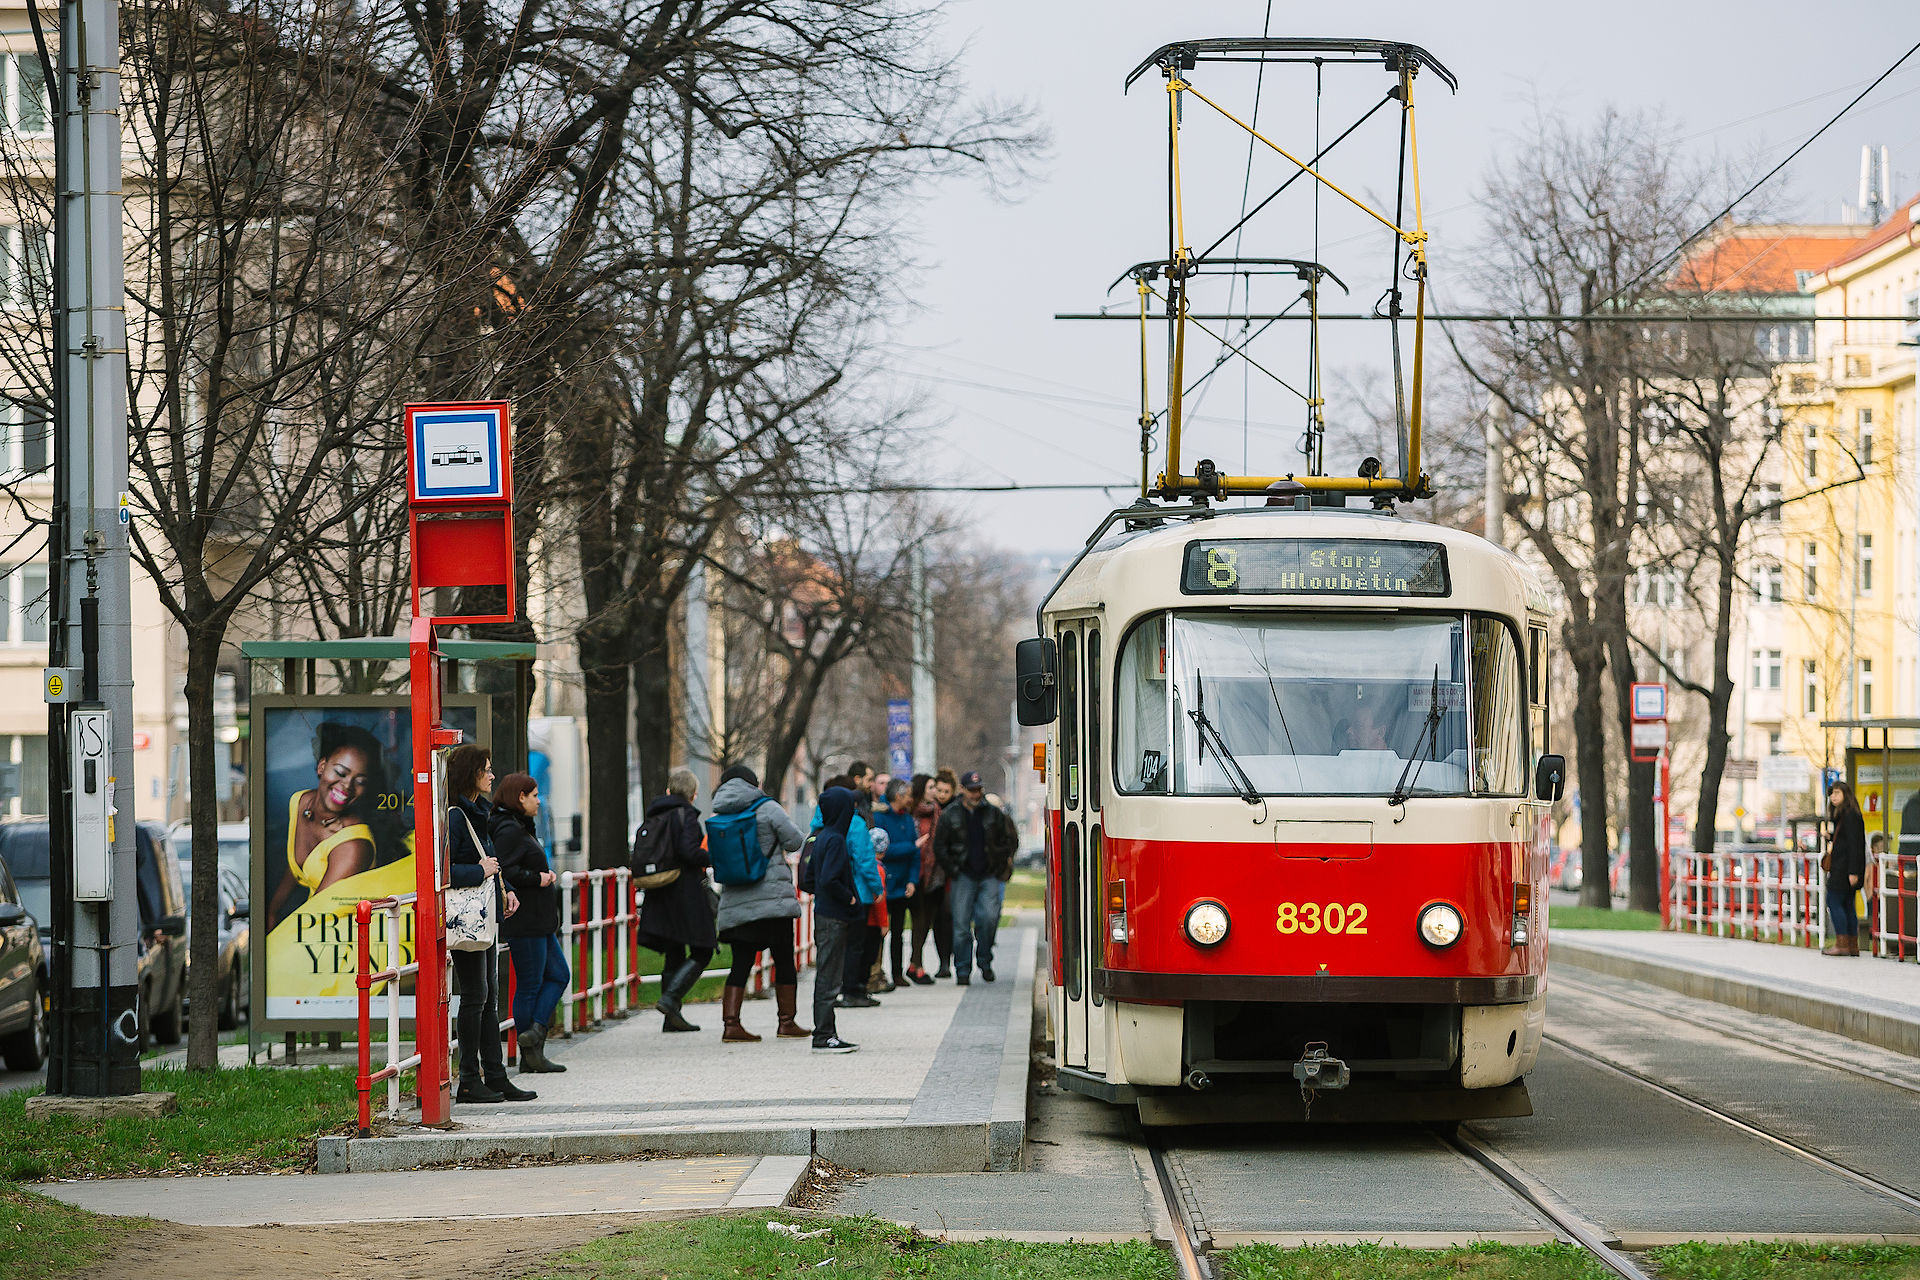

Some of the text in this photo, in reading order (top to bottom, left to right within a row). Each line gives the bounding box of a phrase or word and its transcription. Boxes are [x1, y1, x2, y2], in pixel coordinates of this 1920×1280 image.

[1207, 548, 1238, 588] 8
[1310, 550, 1382, 568] Starý
[1281, 571, 1409, 591] Hloubětín
[1143, 755, 1159, 779] 104
[293, 912, 416, 943] PRETT
[1276, 901, 1368, 935] 8302
[301, 943, 415, 974] YEND
